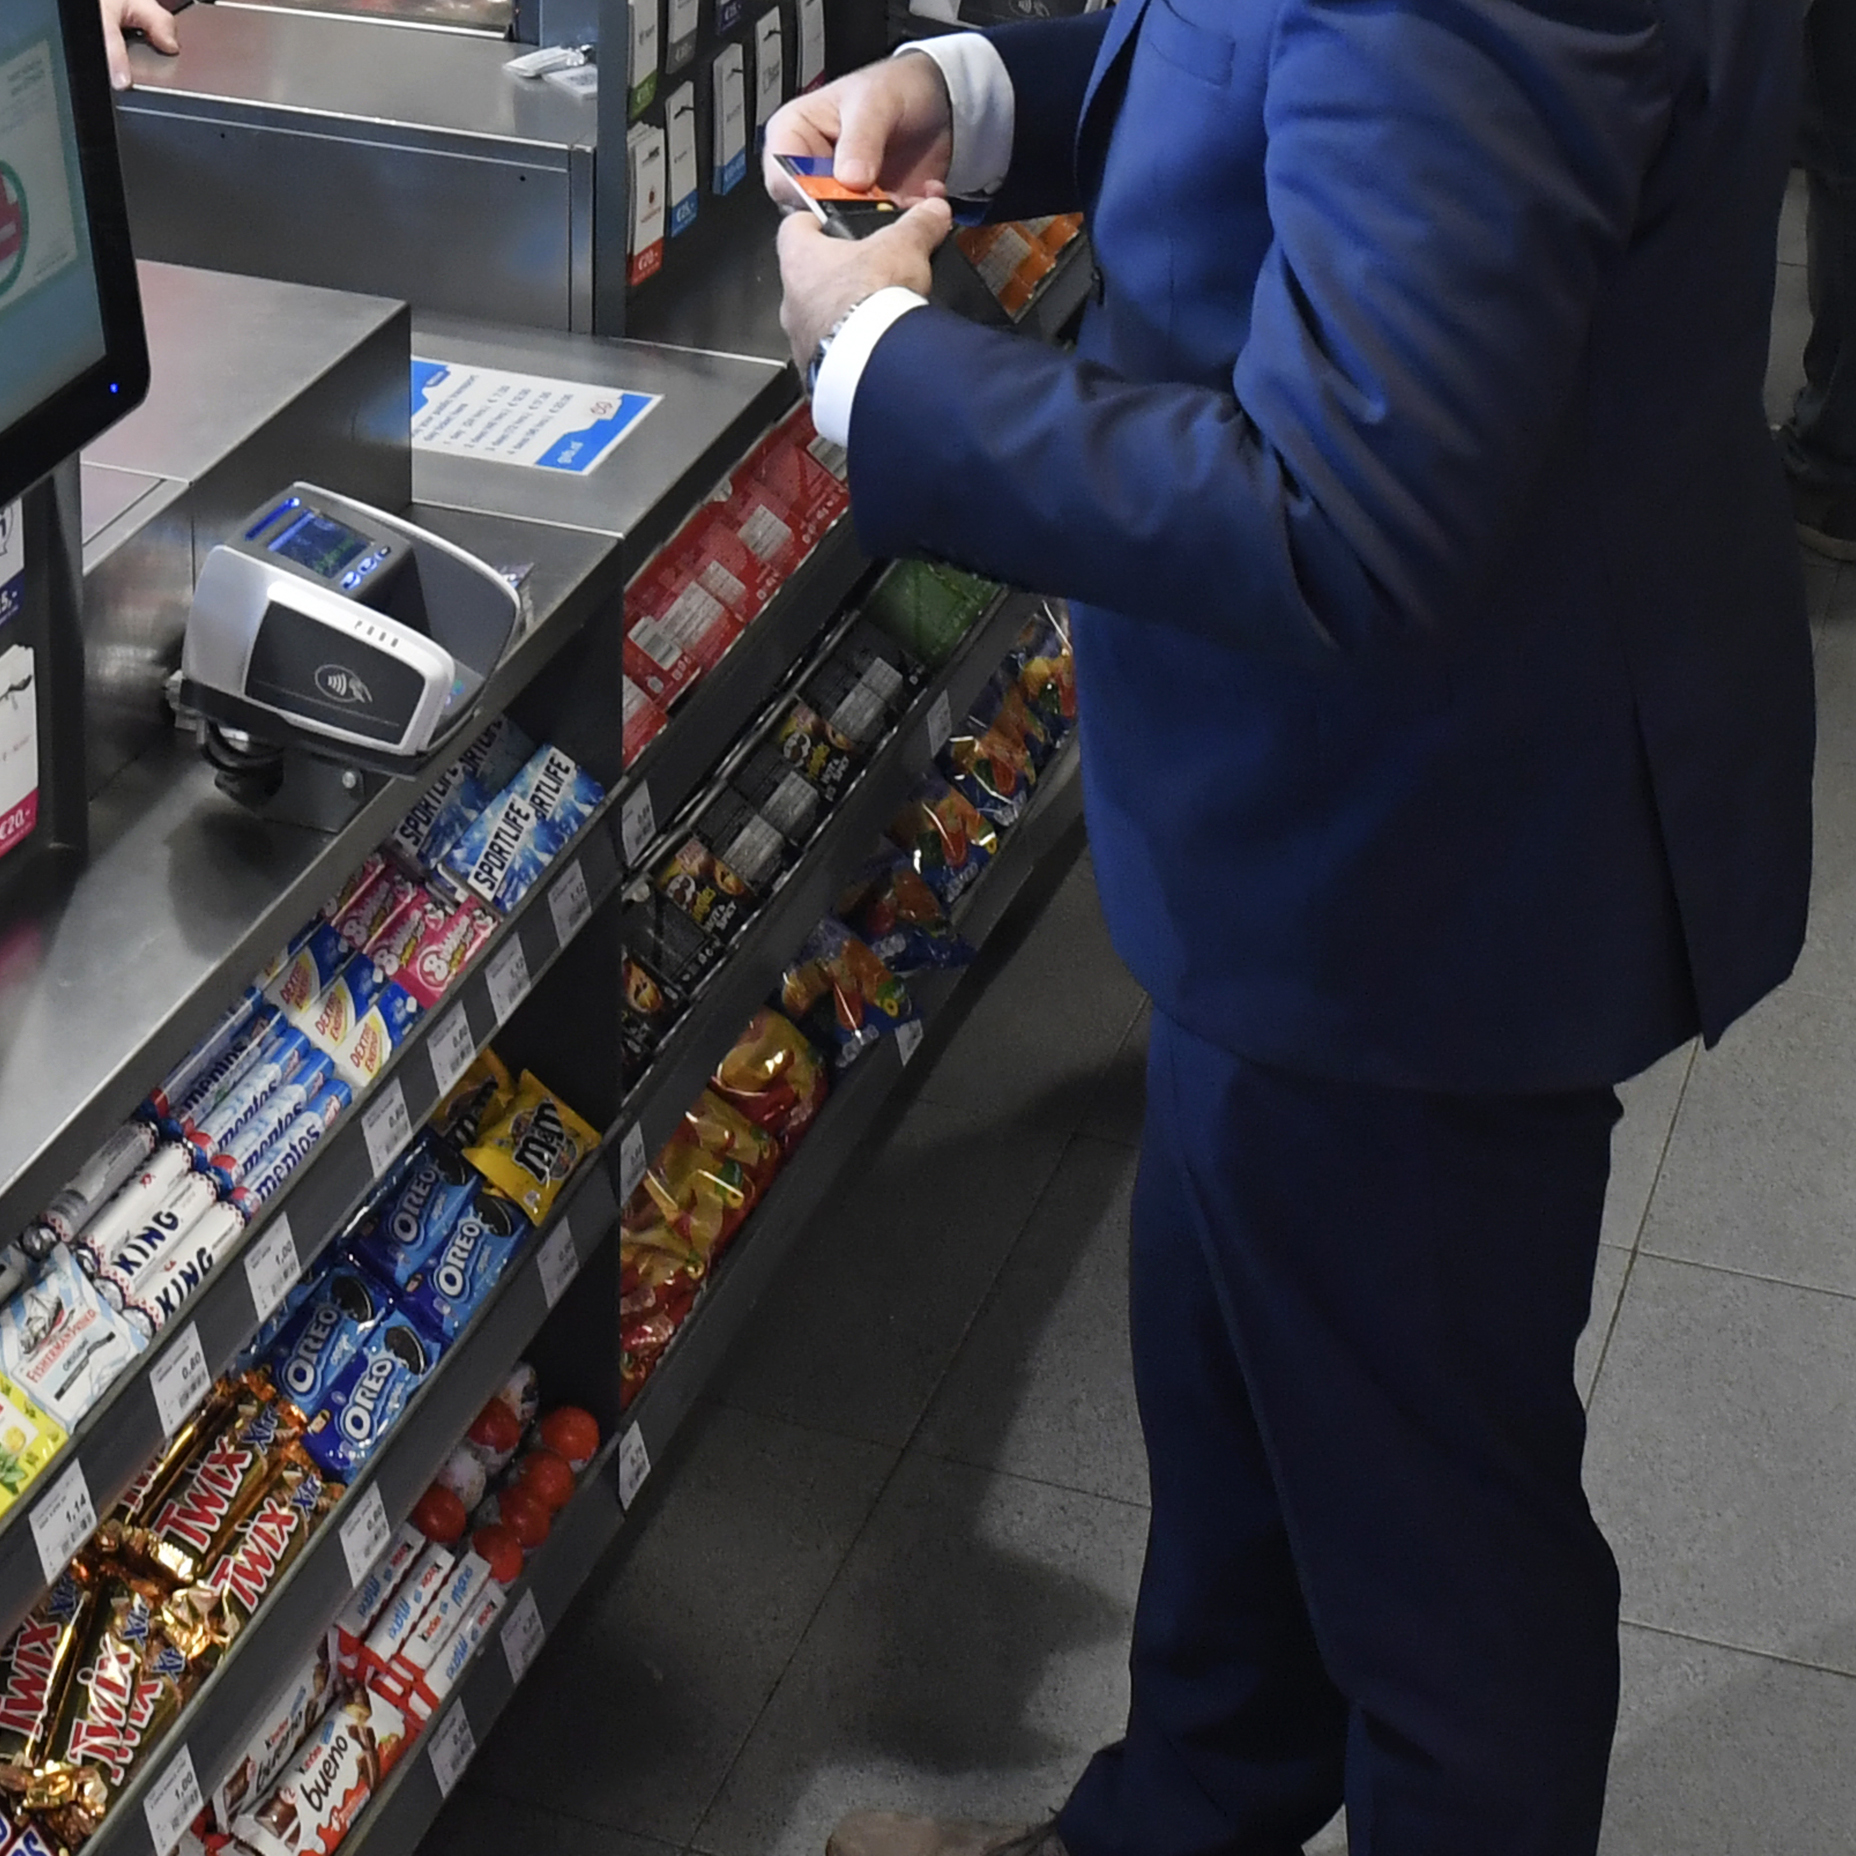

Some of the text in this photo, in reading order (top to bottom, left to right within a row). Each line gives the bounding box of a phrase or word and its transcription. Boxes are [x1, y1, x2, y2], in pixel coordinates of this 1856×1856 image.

[475, 801, 530, 892] SPORTLIFE
[218, 1079, 278, 1150] mentos
[243, 1100, 304, 1175] mentos
[255, 1123, 321, 1203] mentos
[393, 1166, 436, 1243] OREO
[113, 1209, 180, 1277] KING
[154, 1246, 216, 1316] KING
[438, 1221, 481, 1297] OREO
[285, 1305, 338, 1395] OREO
[343, 1358, 393, 1441] OREO
[65, 1495, 86, 1522] 1,14
[173, 1772, 194, 1801] 1,00
[299, 1734, 348, 1813] bueno
